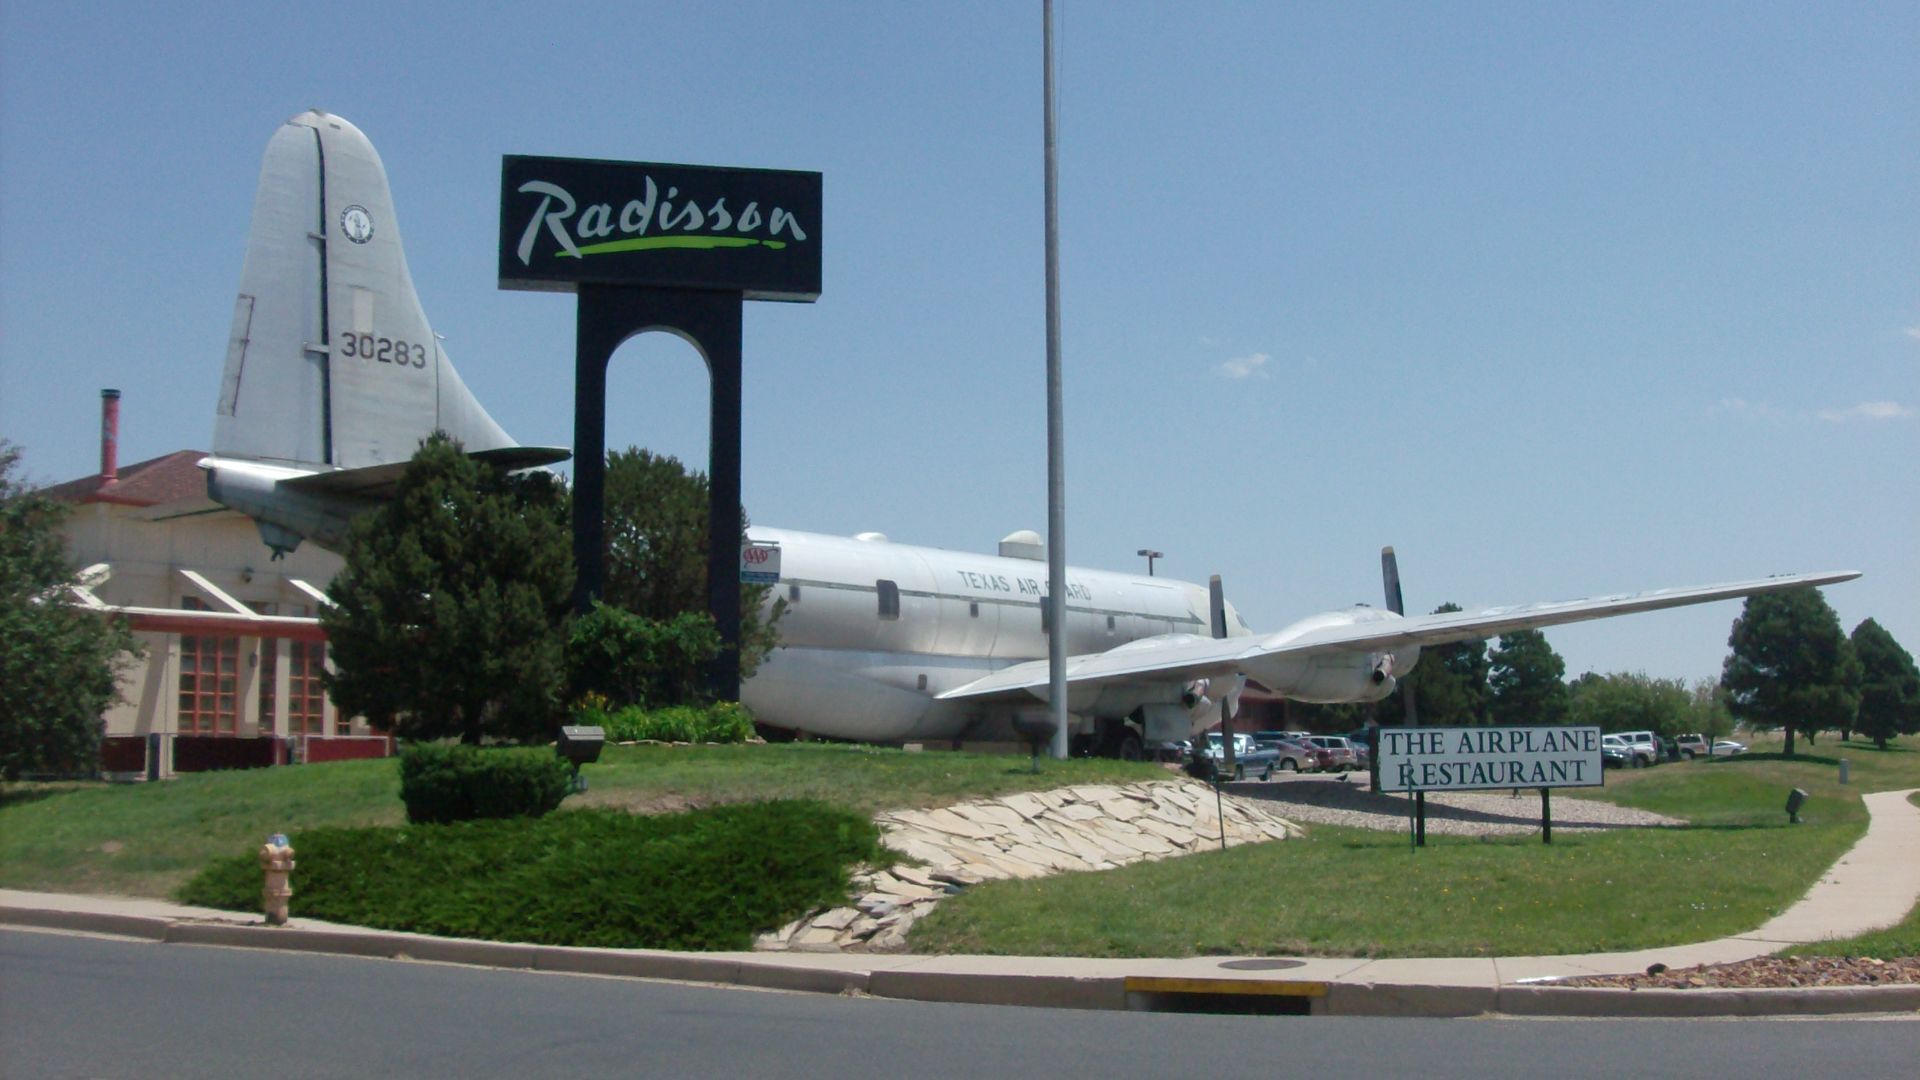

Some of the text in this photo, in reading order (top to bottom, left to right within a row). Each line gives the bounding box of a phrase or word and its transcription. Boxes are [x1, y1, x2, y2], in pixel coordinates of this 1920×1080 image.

[517, 175, 807, 266] Radisson
[340, 331, 427, 370] 30283
[743, 548, 768, 564] AAA
[957, 570, 1091, 601] TEXAS AIR ARD
[1384, 730, 1598, 755] THE AIRPLANE
[1398, 760, 1587, 787] RESTAURANT
